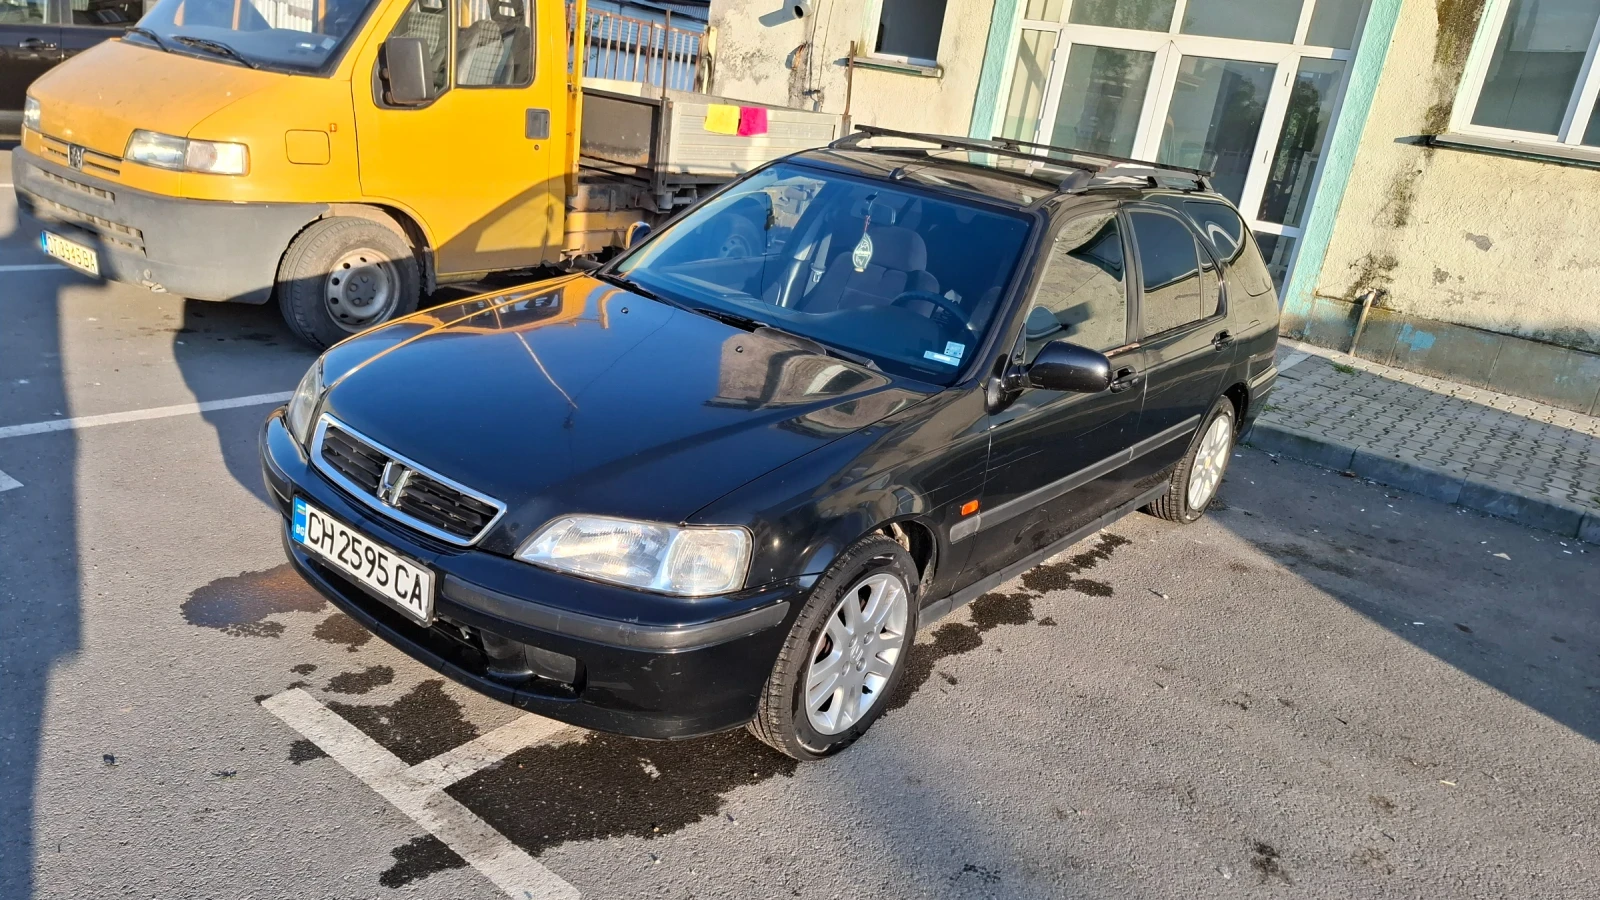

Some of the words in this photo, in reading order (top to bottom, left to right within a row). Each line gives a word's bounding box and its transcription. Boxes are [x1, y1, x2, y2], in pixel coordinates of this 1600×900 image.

[295, 524, 305, 536] BG
[308, 512, 335, 555] CH
[337, 530, 389, 587] 2595
[394, 564, 423, 611] CA
